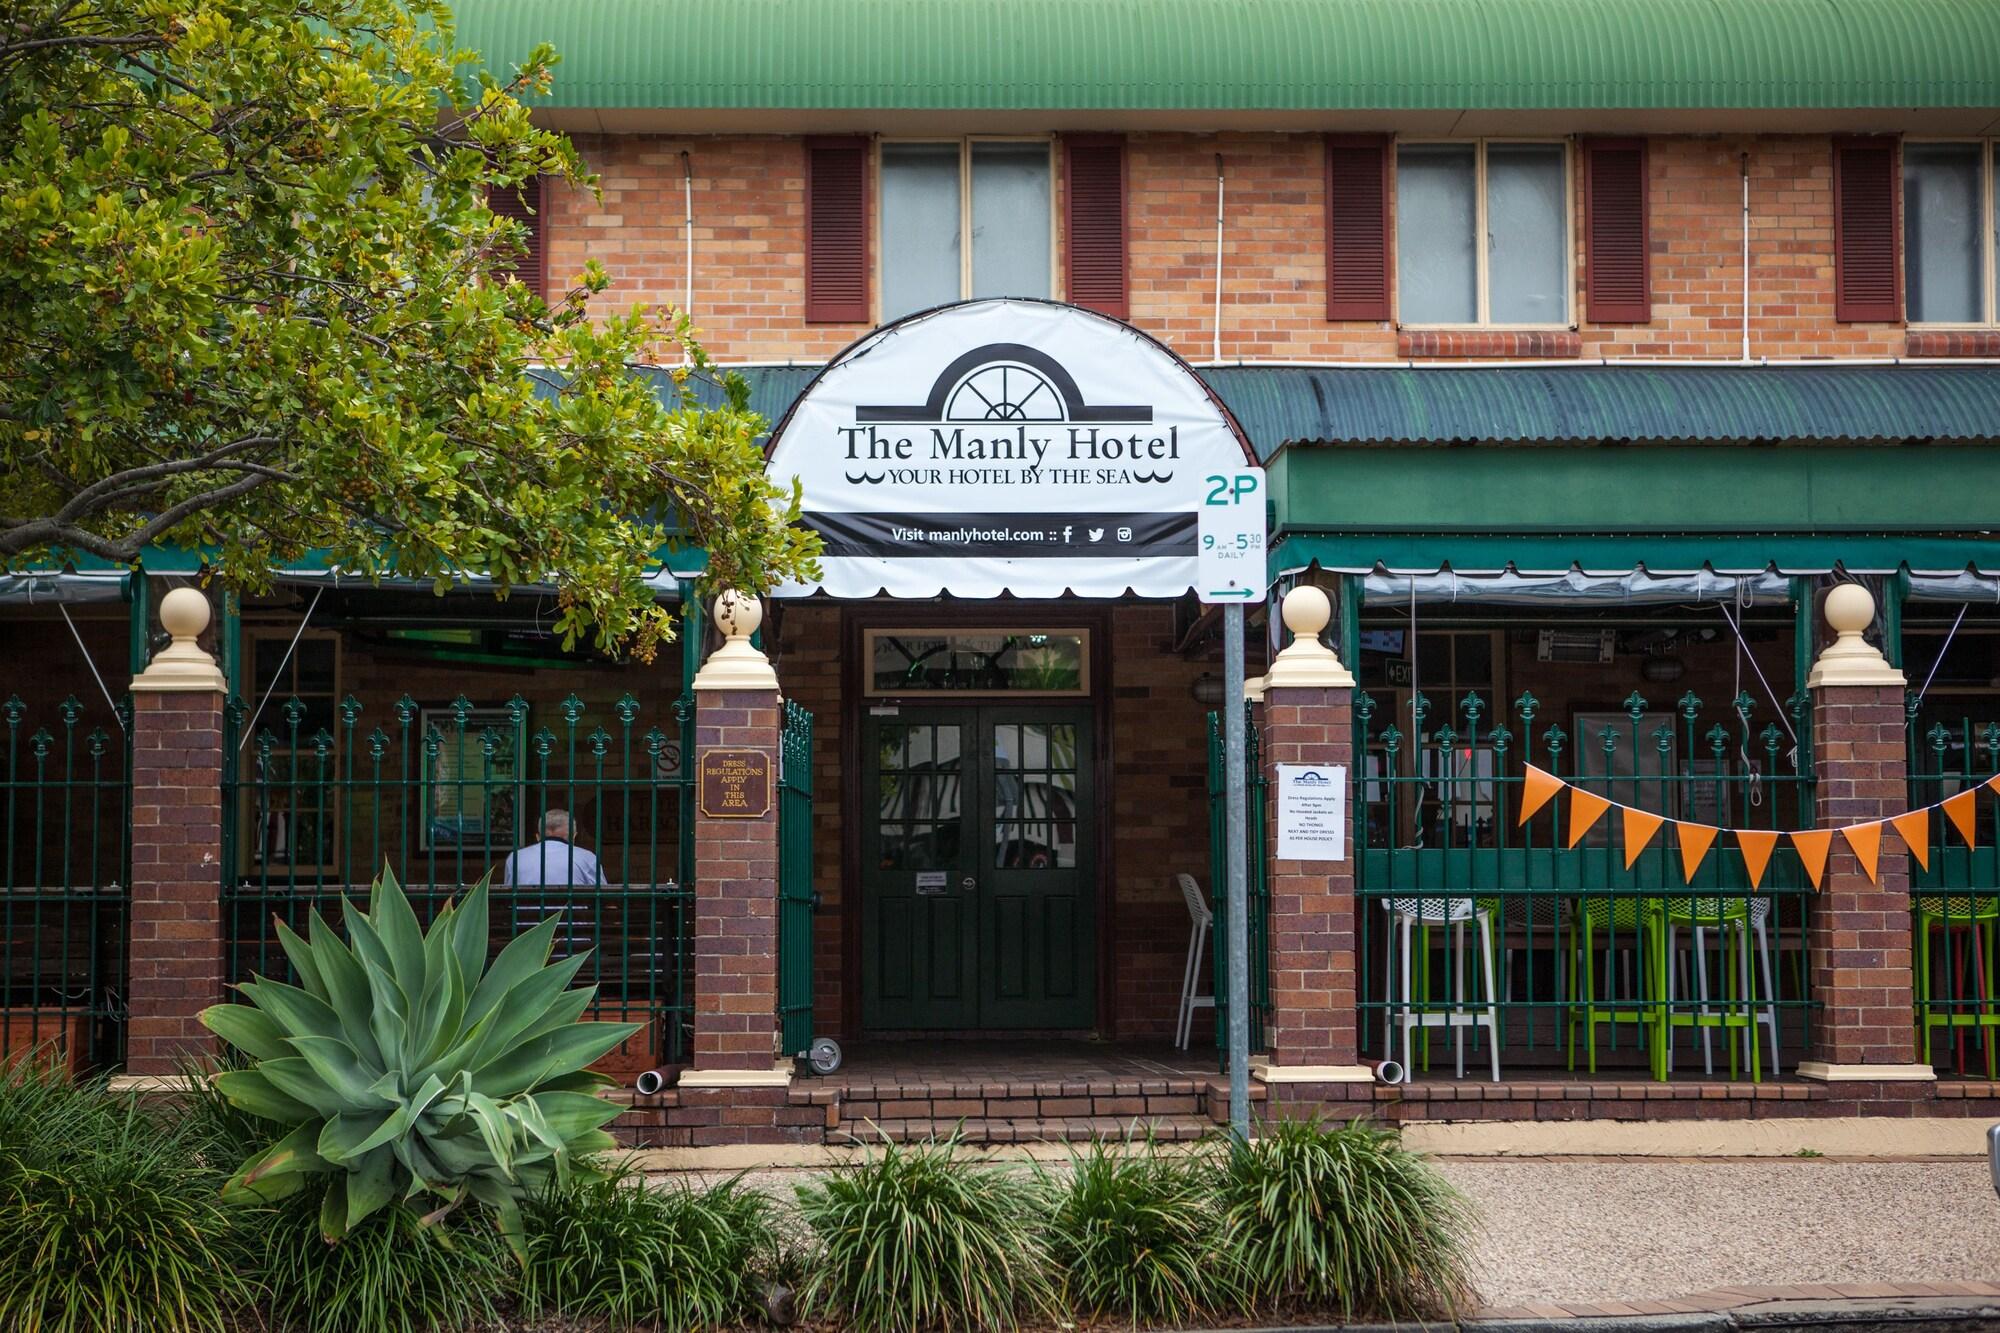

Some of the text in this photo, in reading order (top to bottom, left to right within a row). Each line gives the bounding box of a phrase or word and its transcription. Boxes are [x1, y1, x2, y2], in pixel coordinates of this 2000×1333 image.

[837, 425, 1180, 470] The Manly Hotel
[888, 468, 1132, 485] YOUR HOTEL BY THE SEA
[1205, 475, 1258, 505] 2P
[892, 527, 924, 541] Visit
[929, 527, 1044, 544] manlyhotel.com
[706, 768, 764, 776] REGULATIONS
[721, 799, 748, 807] AREA
